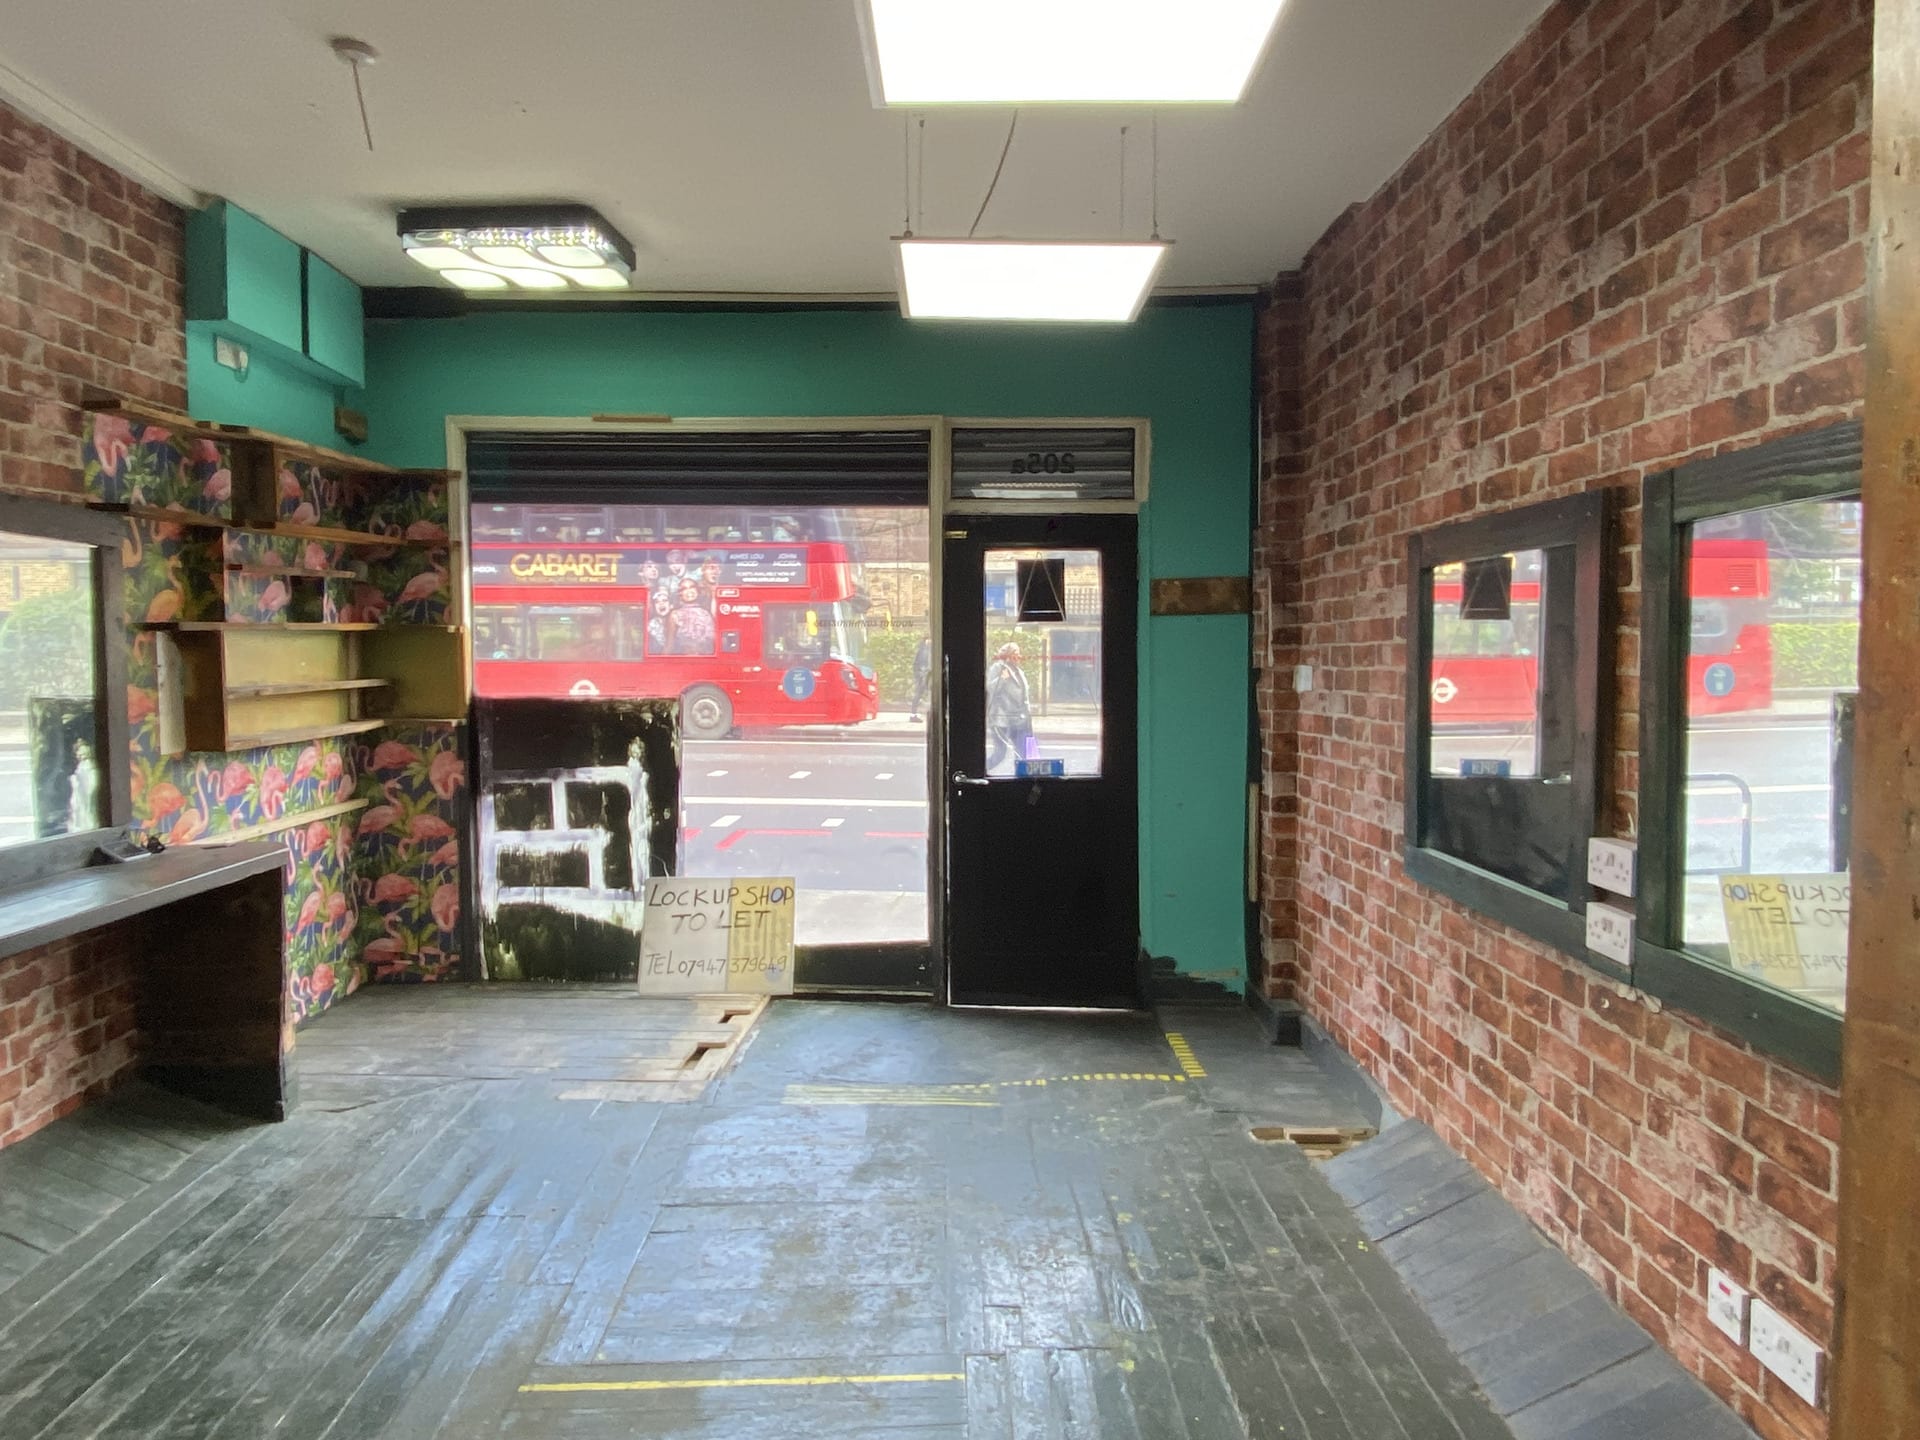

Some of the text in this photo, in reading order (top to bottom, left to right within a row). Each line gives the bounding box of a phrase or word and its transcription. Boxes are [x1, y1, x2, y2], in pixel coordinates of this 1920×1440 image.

[510, 553, 624, 577] CABARET
[742, 885, 794, 907] SHOP
[671, 910, 771, 935] TO LET
[646, 950, 675, 977] TEL
